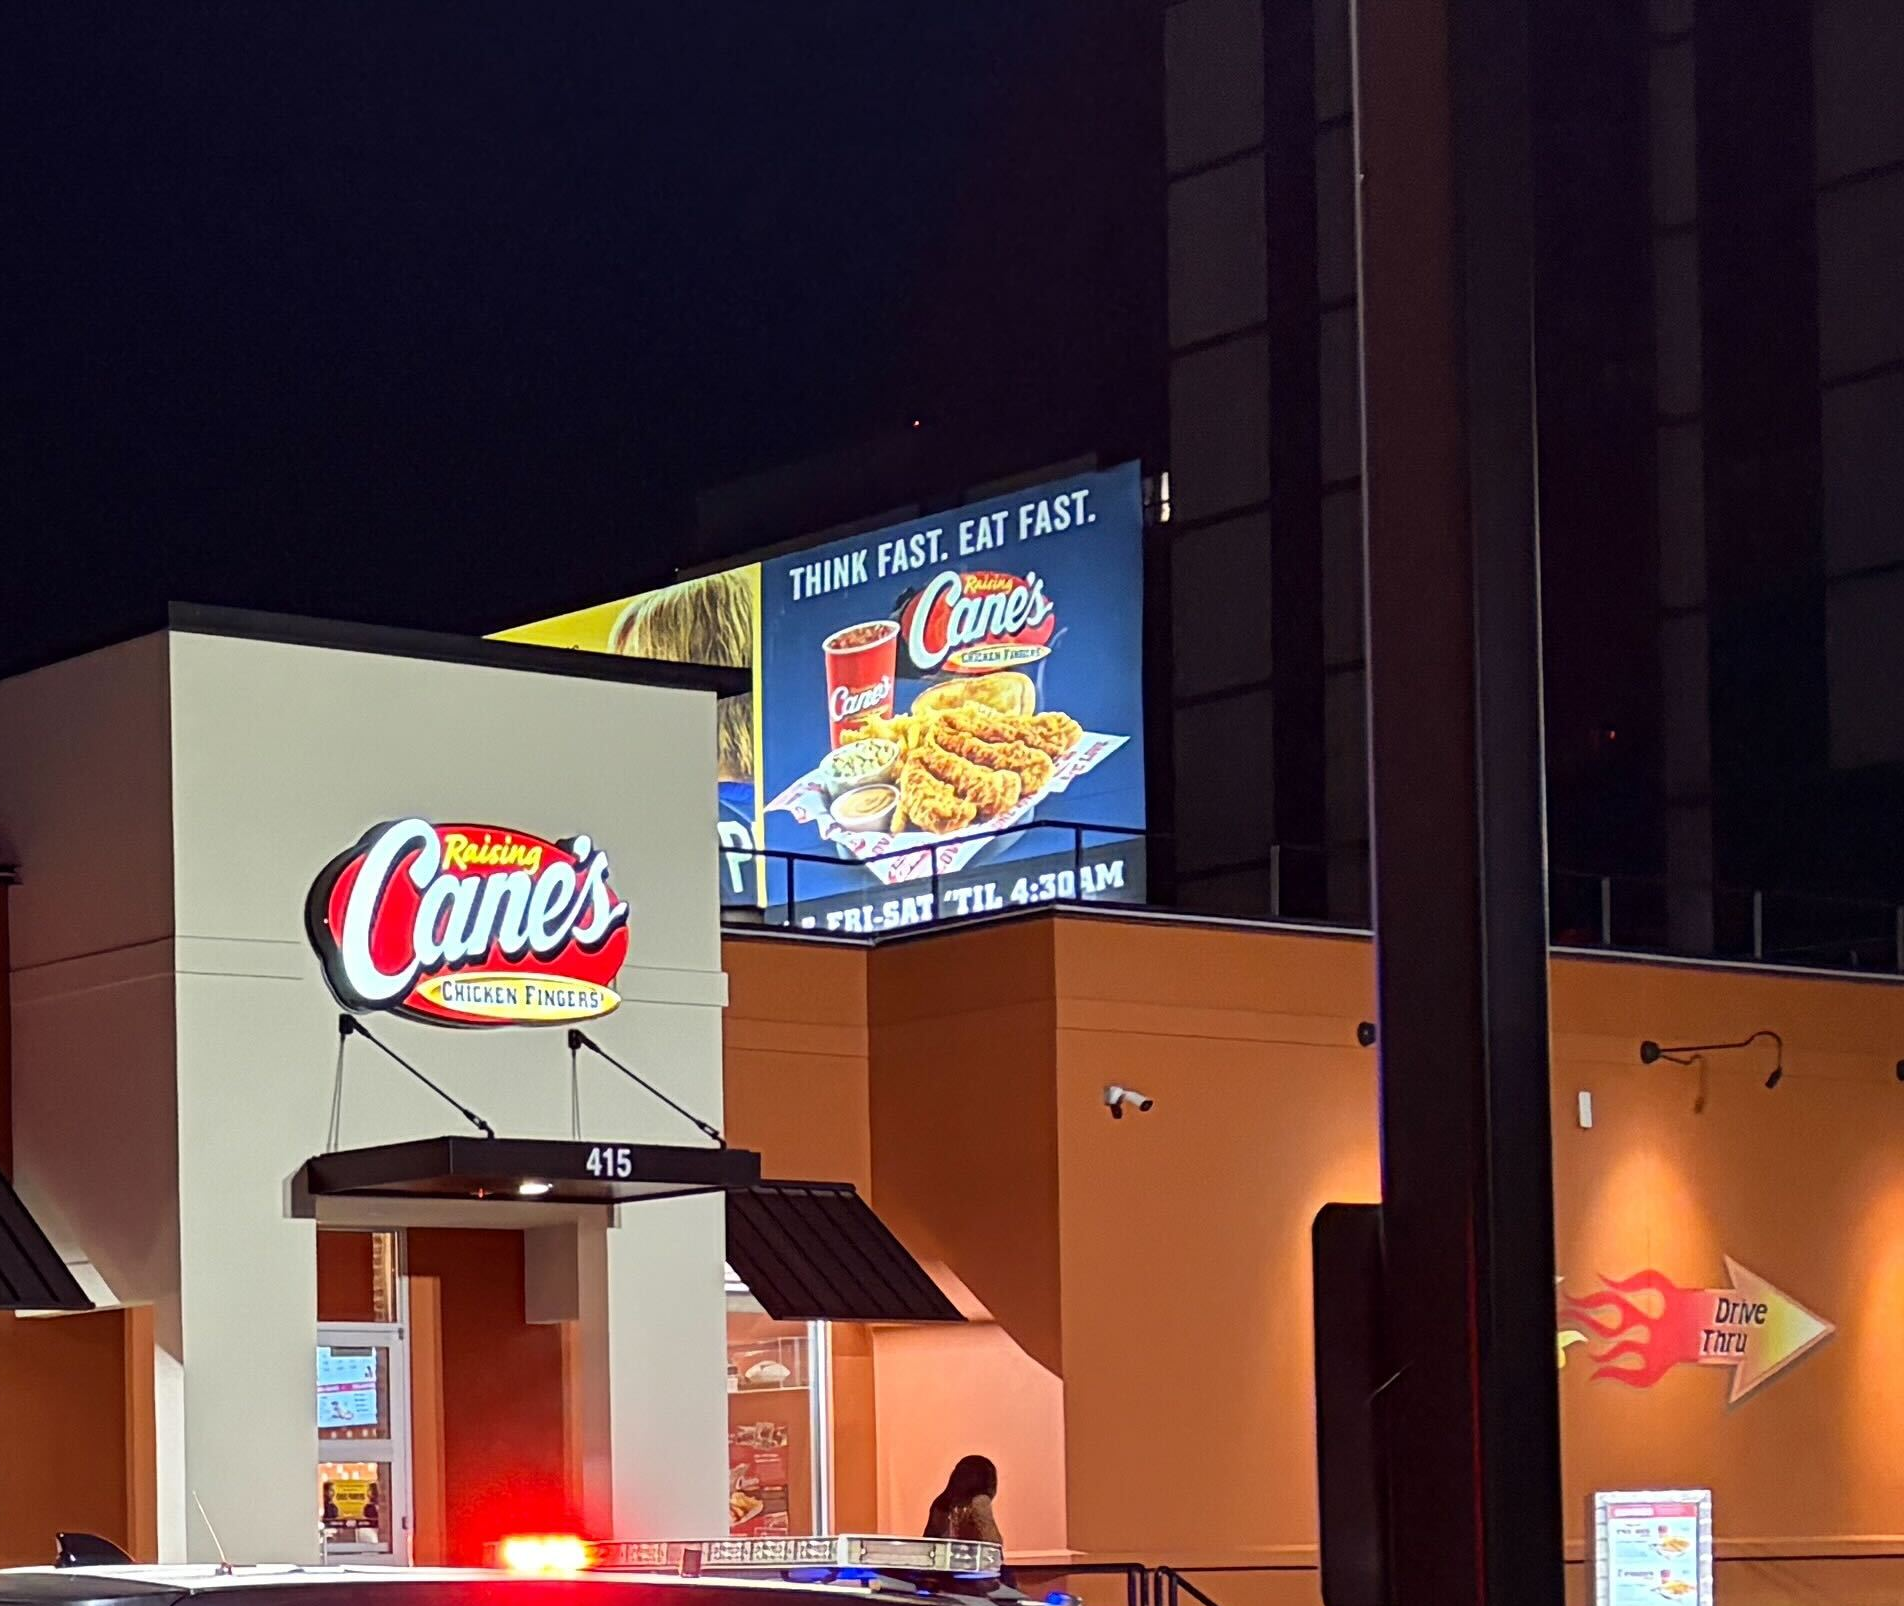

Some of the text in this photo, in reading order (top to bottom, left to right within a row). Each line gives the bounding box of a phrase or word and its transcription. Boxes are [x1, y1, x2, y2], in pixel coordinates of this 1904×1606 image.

[789, 489, 1096, 601] THINK FAST. EAT FAST.
[963, 574, 1013, 596] Raising
[909, 571, 1053, 670] Cane's
[442, 834, 543, 874] Raising
[342, 818, 629, 1001] Cane's
[826, 893, 935, 933] FRI-SAT
[442, 980, 601, 1010] CHICKEN FINGERS
[586, 1148, 632, 1178] 415
[1715, 1297, 1767, 1327] Drive
[1702, 1329, 1747, 1355] Thru
